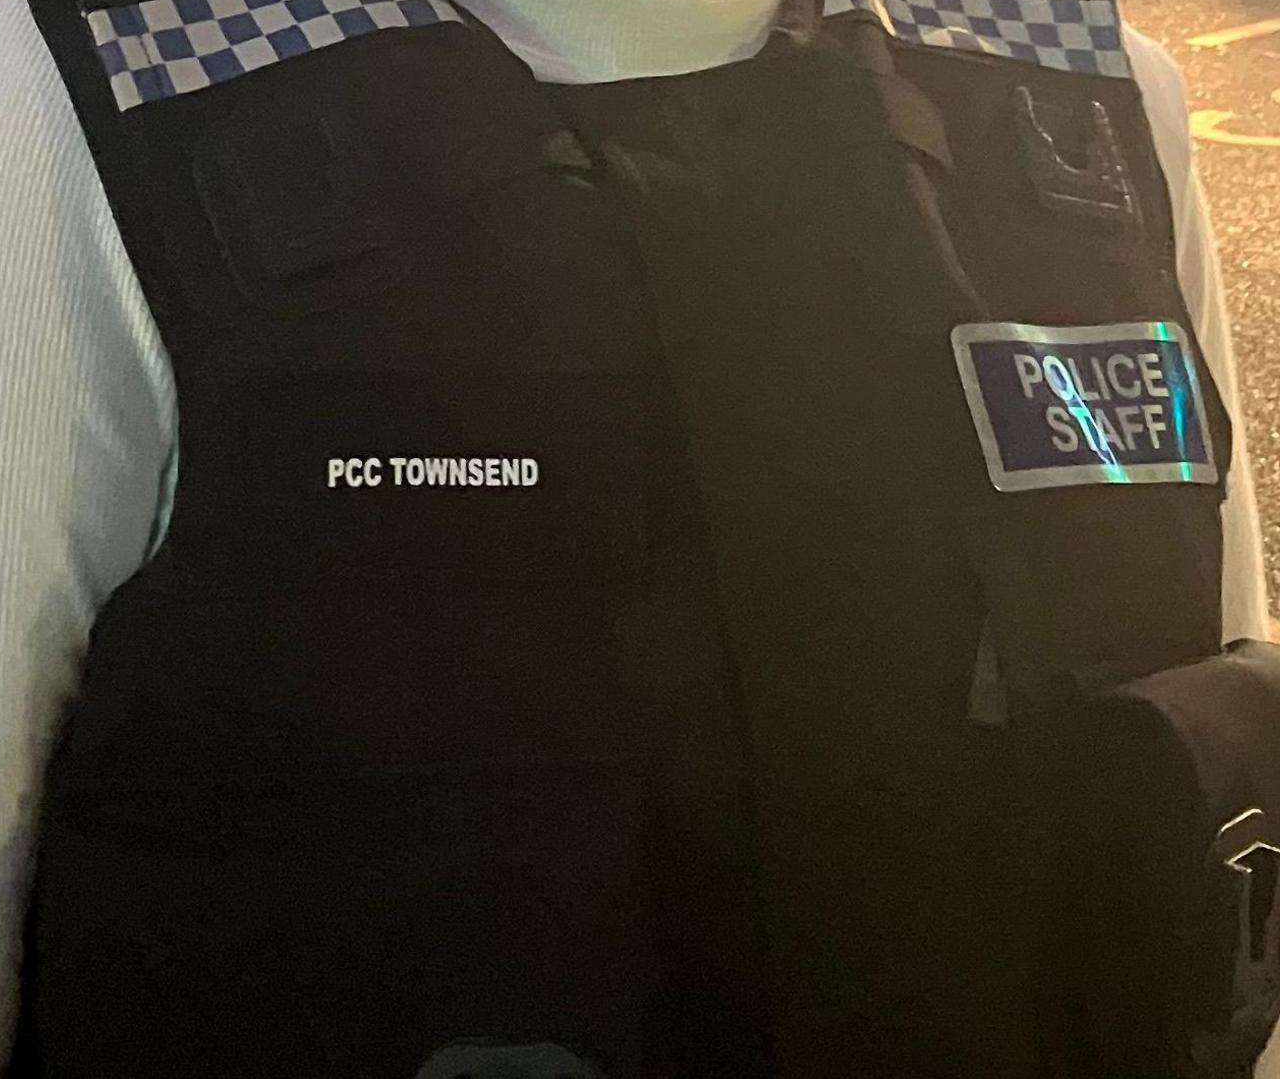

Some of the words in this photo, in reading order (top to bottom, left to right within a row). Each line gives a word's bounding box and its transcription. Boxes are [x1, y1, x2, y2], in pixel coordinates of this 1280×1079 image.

[1014, 352, 1169, 401] POLICE
[1045, 404, 1167, 454] STAFF
[328, 457, 382, 488] PCC
[389, 457, 539, 487] TOWNSEND
